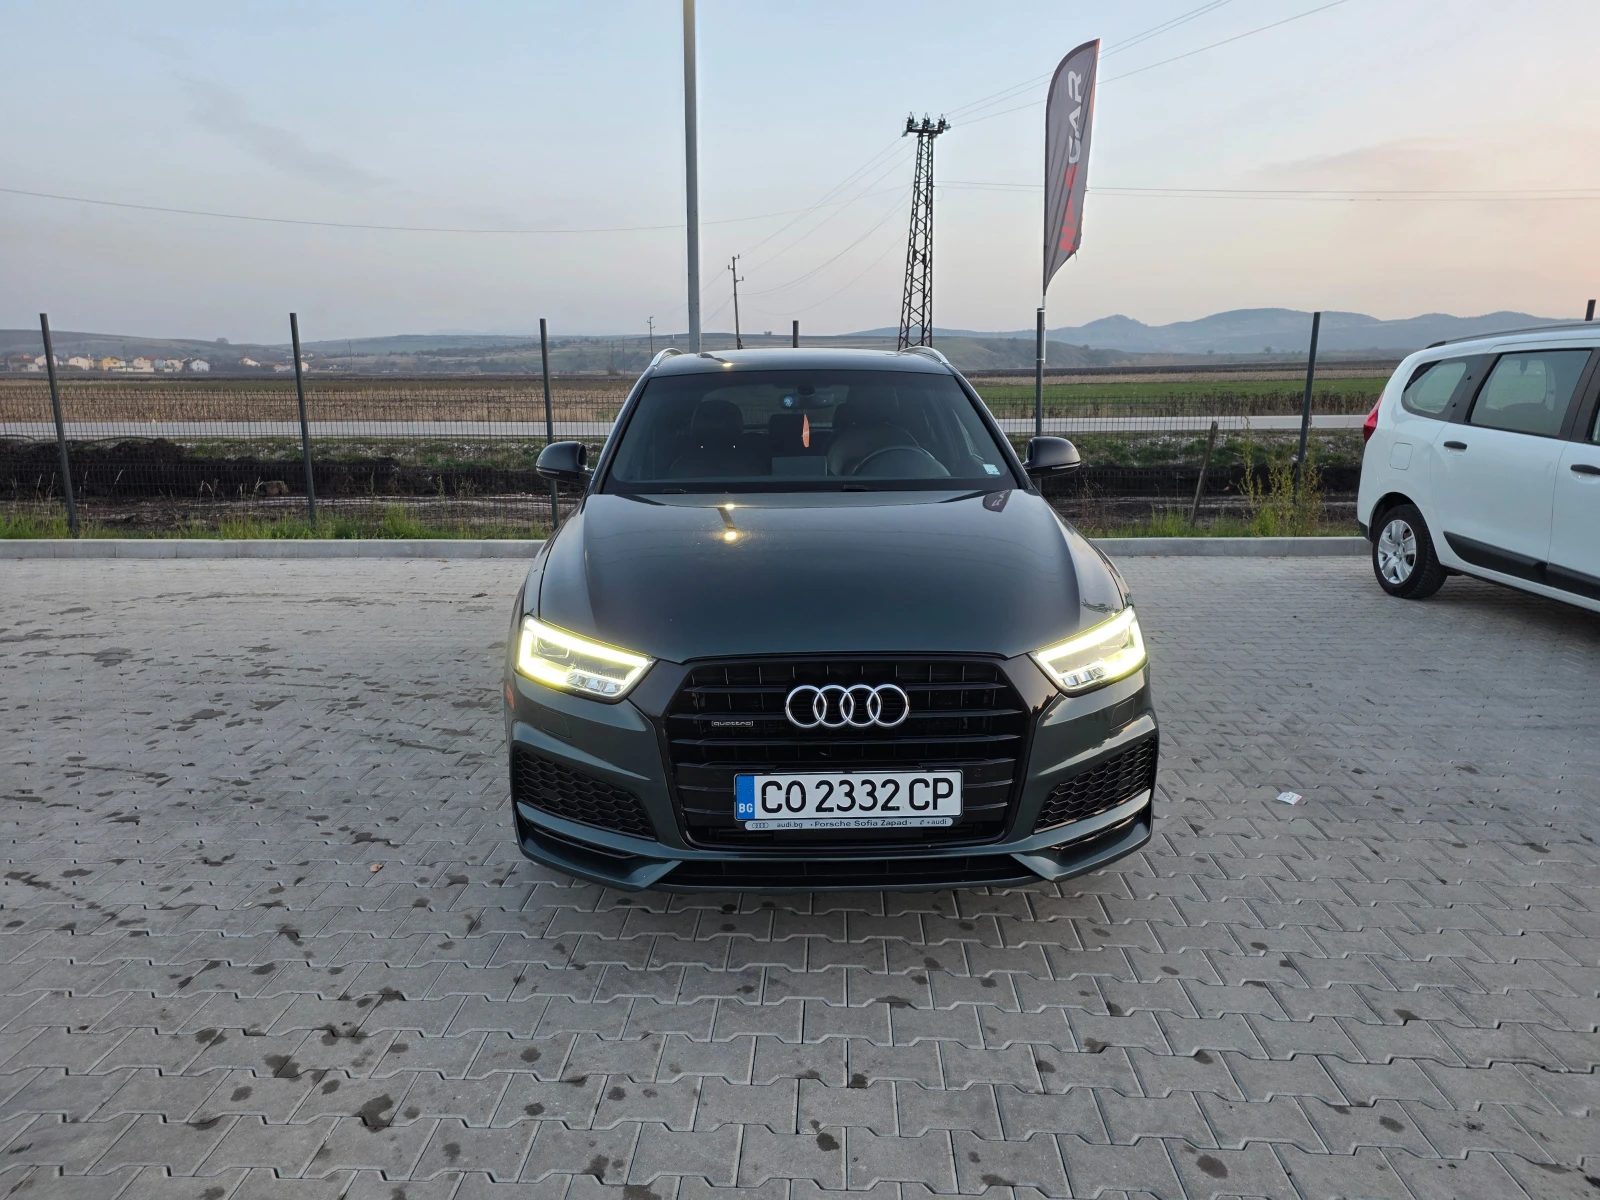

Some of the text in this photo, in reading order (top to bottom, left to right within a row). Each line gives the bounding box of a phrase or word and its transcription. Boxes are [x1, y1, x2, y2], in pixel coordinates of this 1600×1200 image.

[761, 777, 954, 814] CO 2332 CP
[738, 803, 753, 813] BG
[776, 821, 803, 829] audi.bg
[814, 820, 852, 828] Porsche
[854, 819, 878, 827] Sofia
[880, 819, 908, 828] Zapad
